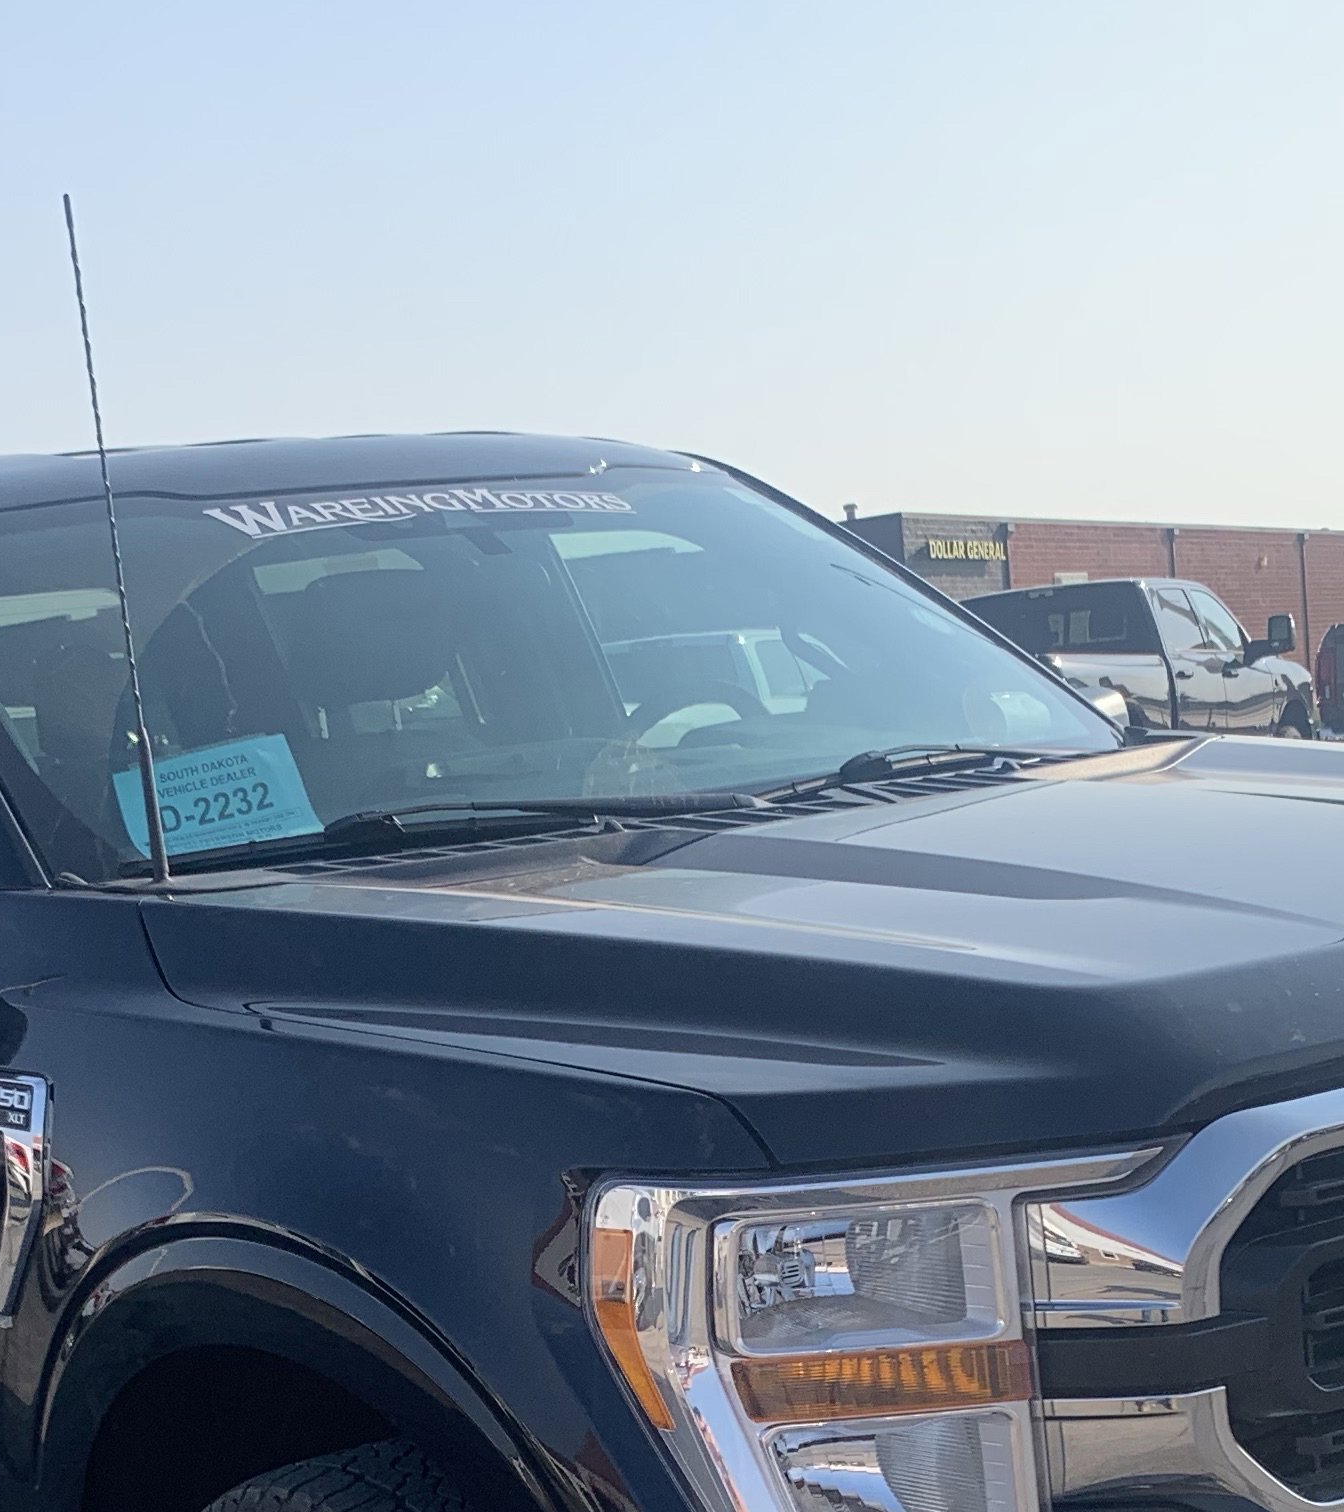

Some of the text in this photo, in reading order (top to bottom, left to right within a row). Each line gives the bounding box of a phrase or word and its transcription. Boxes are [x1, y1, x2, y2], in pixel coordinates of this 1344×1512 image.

[929, 540, 1006, 560] DOLLAR GENERAL
[157, 766, 257, 799] VEHICLE DEALER
[159, 753, 248, 784] SOUTH DAKOTA
[160, 782, 274, 834] D-2232
[8, 1111, 25, 1125] XLT
